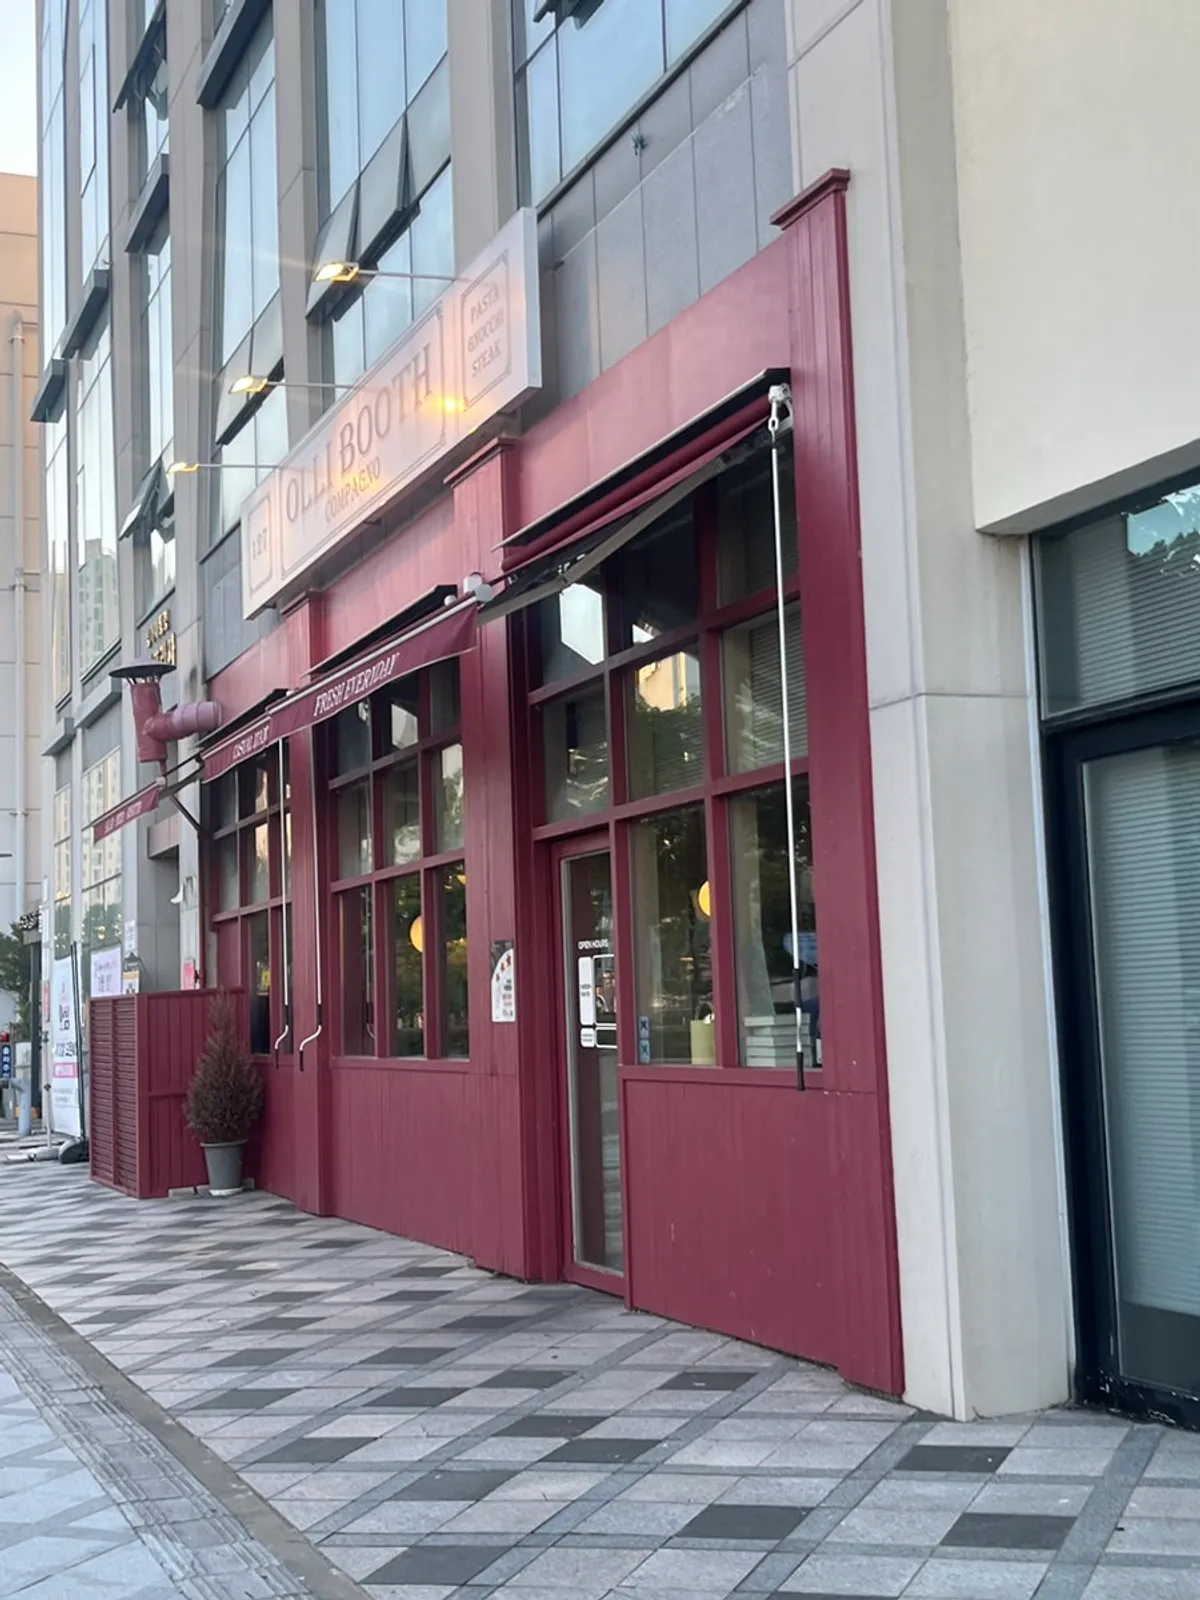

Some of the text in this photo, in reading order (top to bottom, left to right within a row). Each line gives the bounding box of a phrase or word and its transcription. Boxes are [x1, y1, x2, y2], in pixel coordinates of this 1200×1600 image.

[470, 280, 499, 324] PASTA
[472, 339, 501, 377] STEAK
[286, 342, 433, 522] OLLI BOOTH
